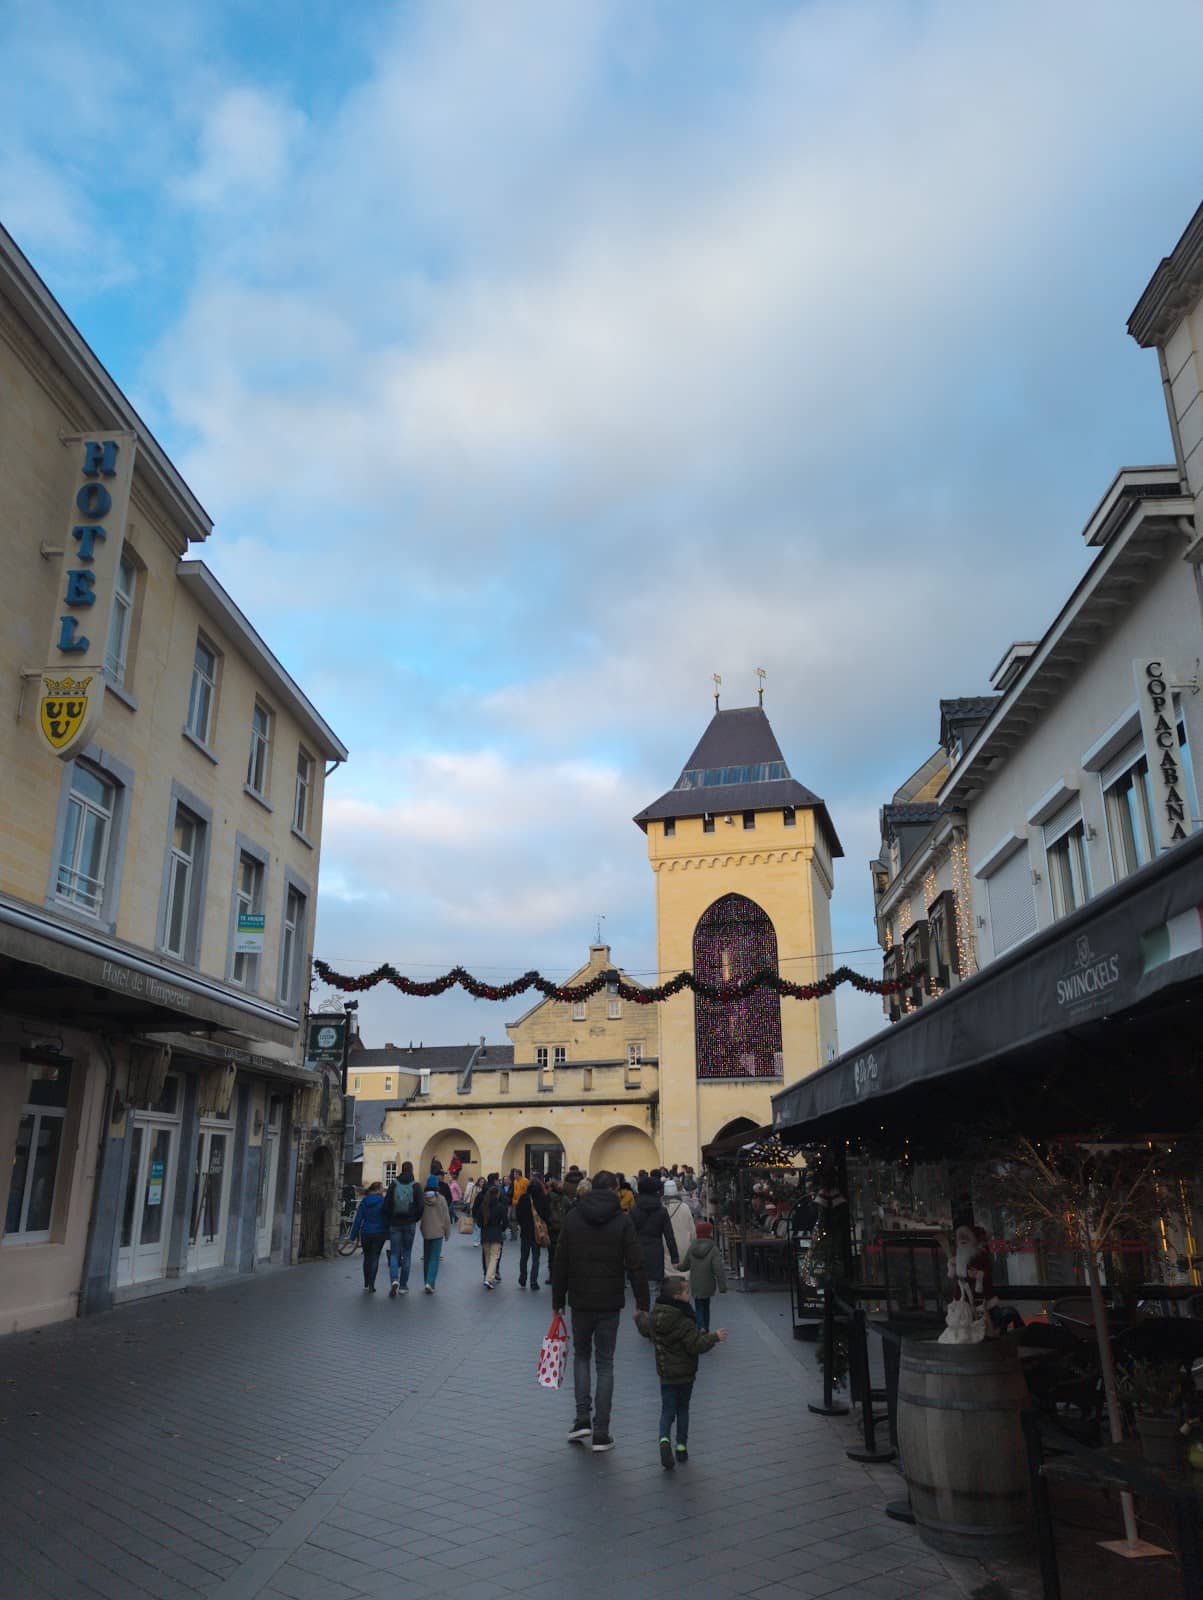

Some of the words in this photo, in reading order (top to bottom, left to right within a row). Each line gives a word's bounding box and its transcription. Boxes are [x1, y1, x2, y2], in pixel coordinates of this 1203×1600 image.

[57, 440, 120, 654] HOTEL
[1146, 662, 1188, 840] COPACABANA
[102, 961, 130, 989] Hotel
[131, 972, 143, 992] de
